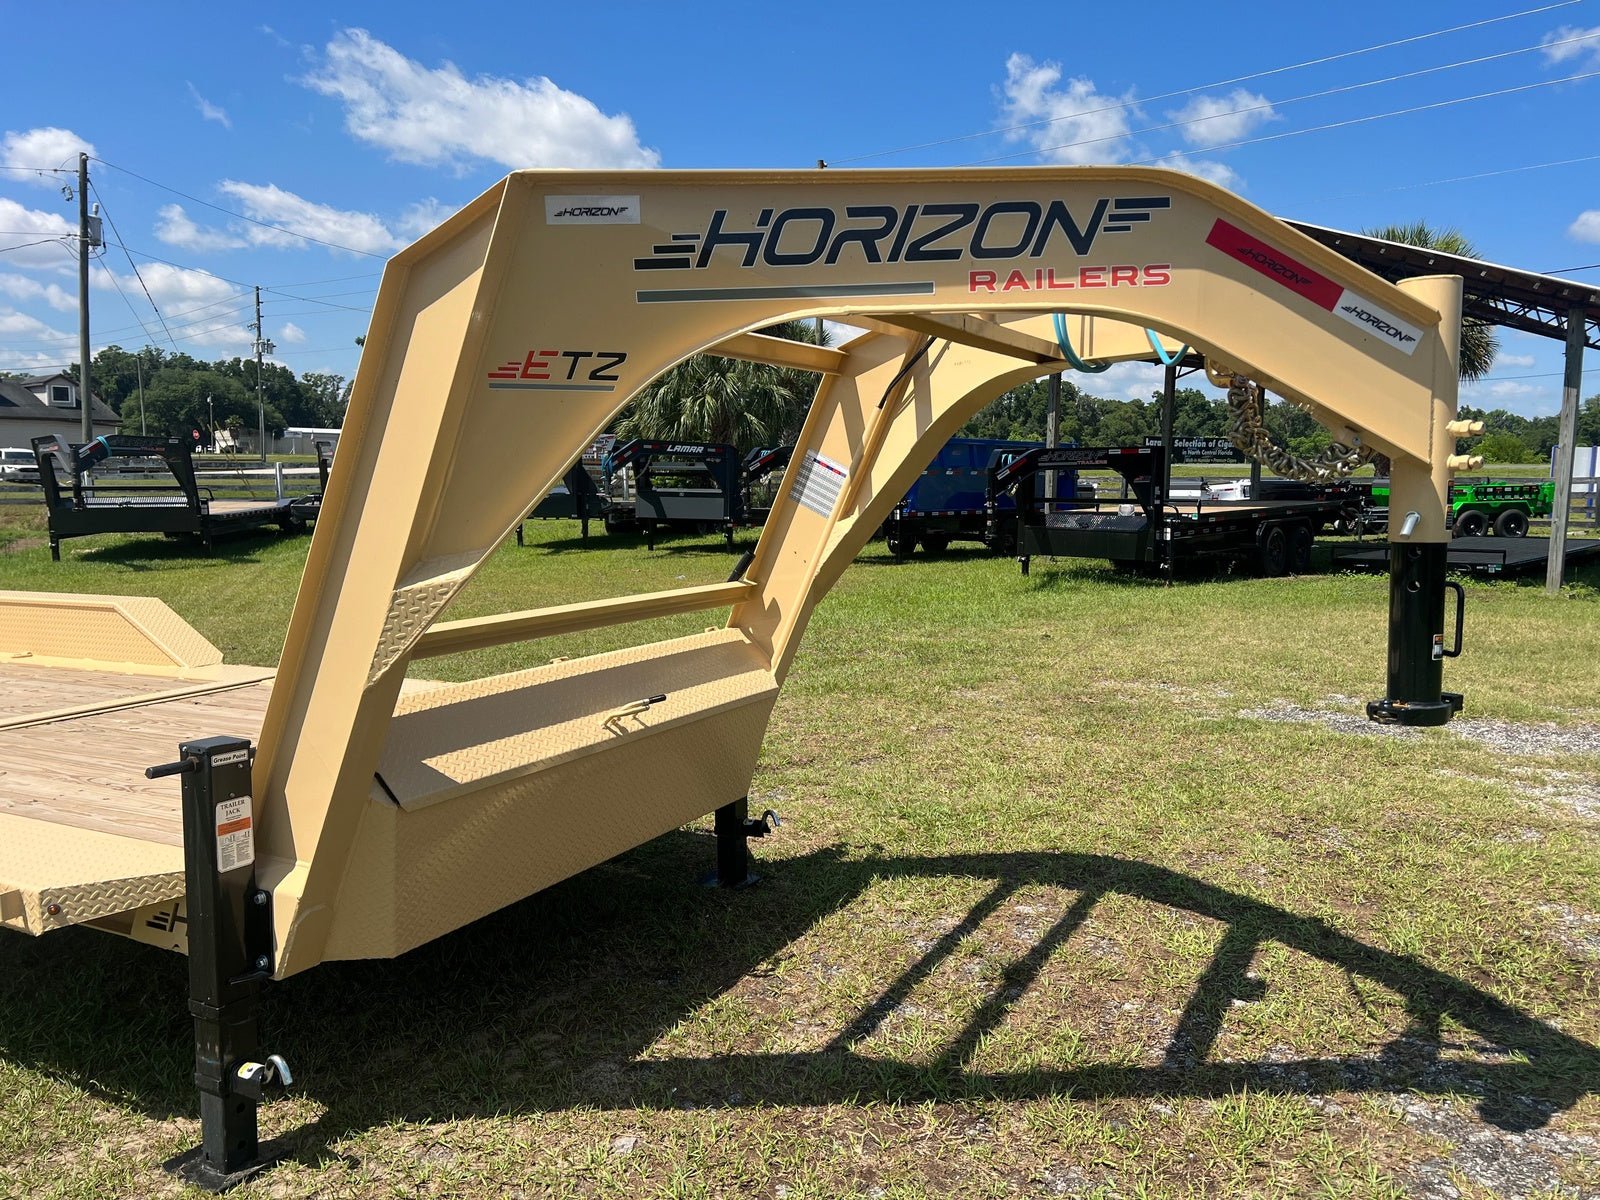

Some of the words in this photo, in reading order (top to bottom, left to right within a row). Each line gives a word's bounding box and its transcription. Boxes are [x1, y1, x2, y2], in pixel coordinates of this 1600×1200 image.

[562, 207, 620, 217] HORIZON
[694, 199, 1110, 268] HORIZON
[1247, 248, 1302, 284] HORIZON
[968, 264, 1171, 292] RAILERS
[1350, 306, 1407, 342] HORIZON
[667, 444, 705, 454] LAMAR
[1174, 439, 1206, 448] Selection
[1208, 439, 1216, 448] of
[1217, 439, 1233, 450] Ciga
[213, 755, 231, 764] Grease
[232, 752, 246, 761] Point
[220, 800, 245, 809] TRAILER
